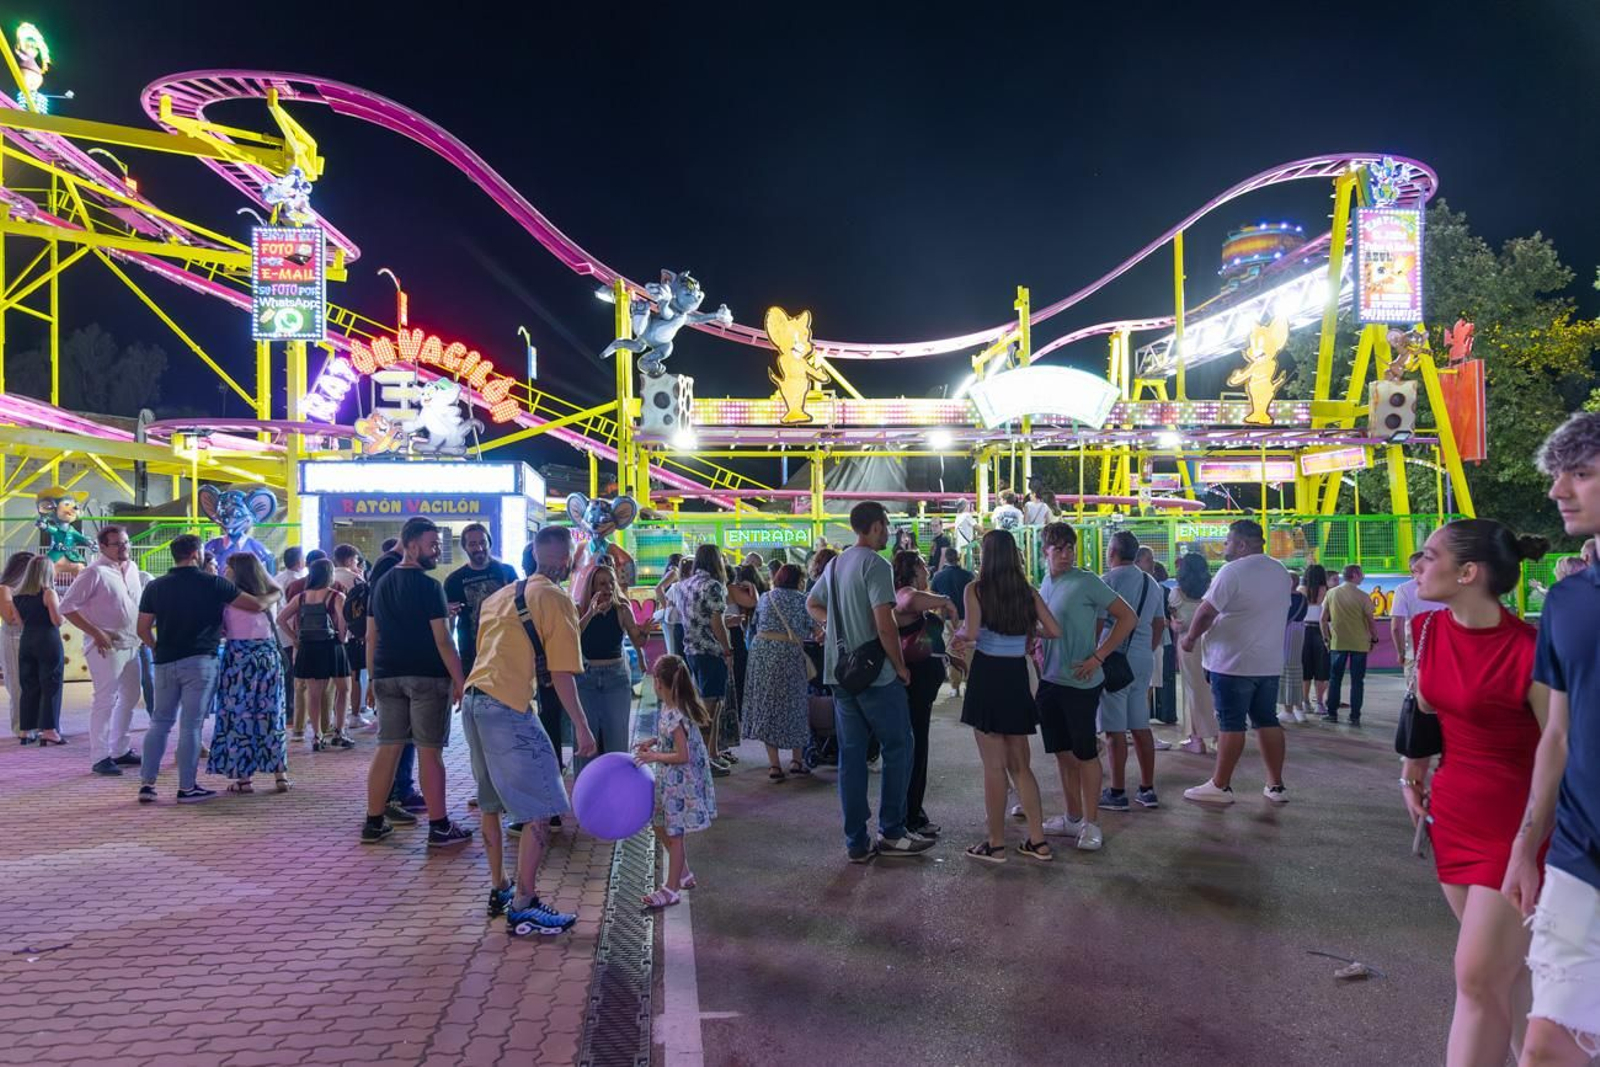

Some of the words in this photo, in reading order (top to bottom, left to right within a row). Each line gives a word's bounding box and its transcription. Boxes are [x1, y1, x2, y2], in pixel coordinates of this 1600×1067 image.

[261, 243, 293, 254] FOTO
[261, 257, 283, 266] POR
[261, 268, 315, 280] E-MAIL
[259, 286, 271, 295] SU
[271, 284, 298, 296] FOTO
[298, 286, 317, 295] POR
[259, 297, 318, 310] WhatsApp
[342, 498, 401, 513] RATÓN
[406, 498, 480, 513] VACILÓN
[729, 529, 807, 542] ENTRADA
[1180, 524, 1230, 537] ENTRA
